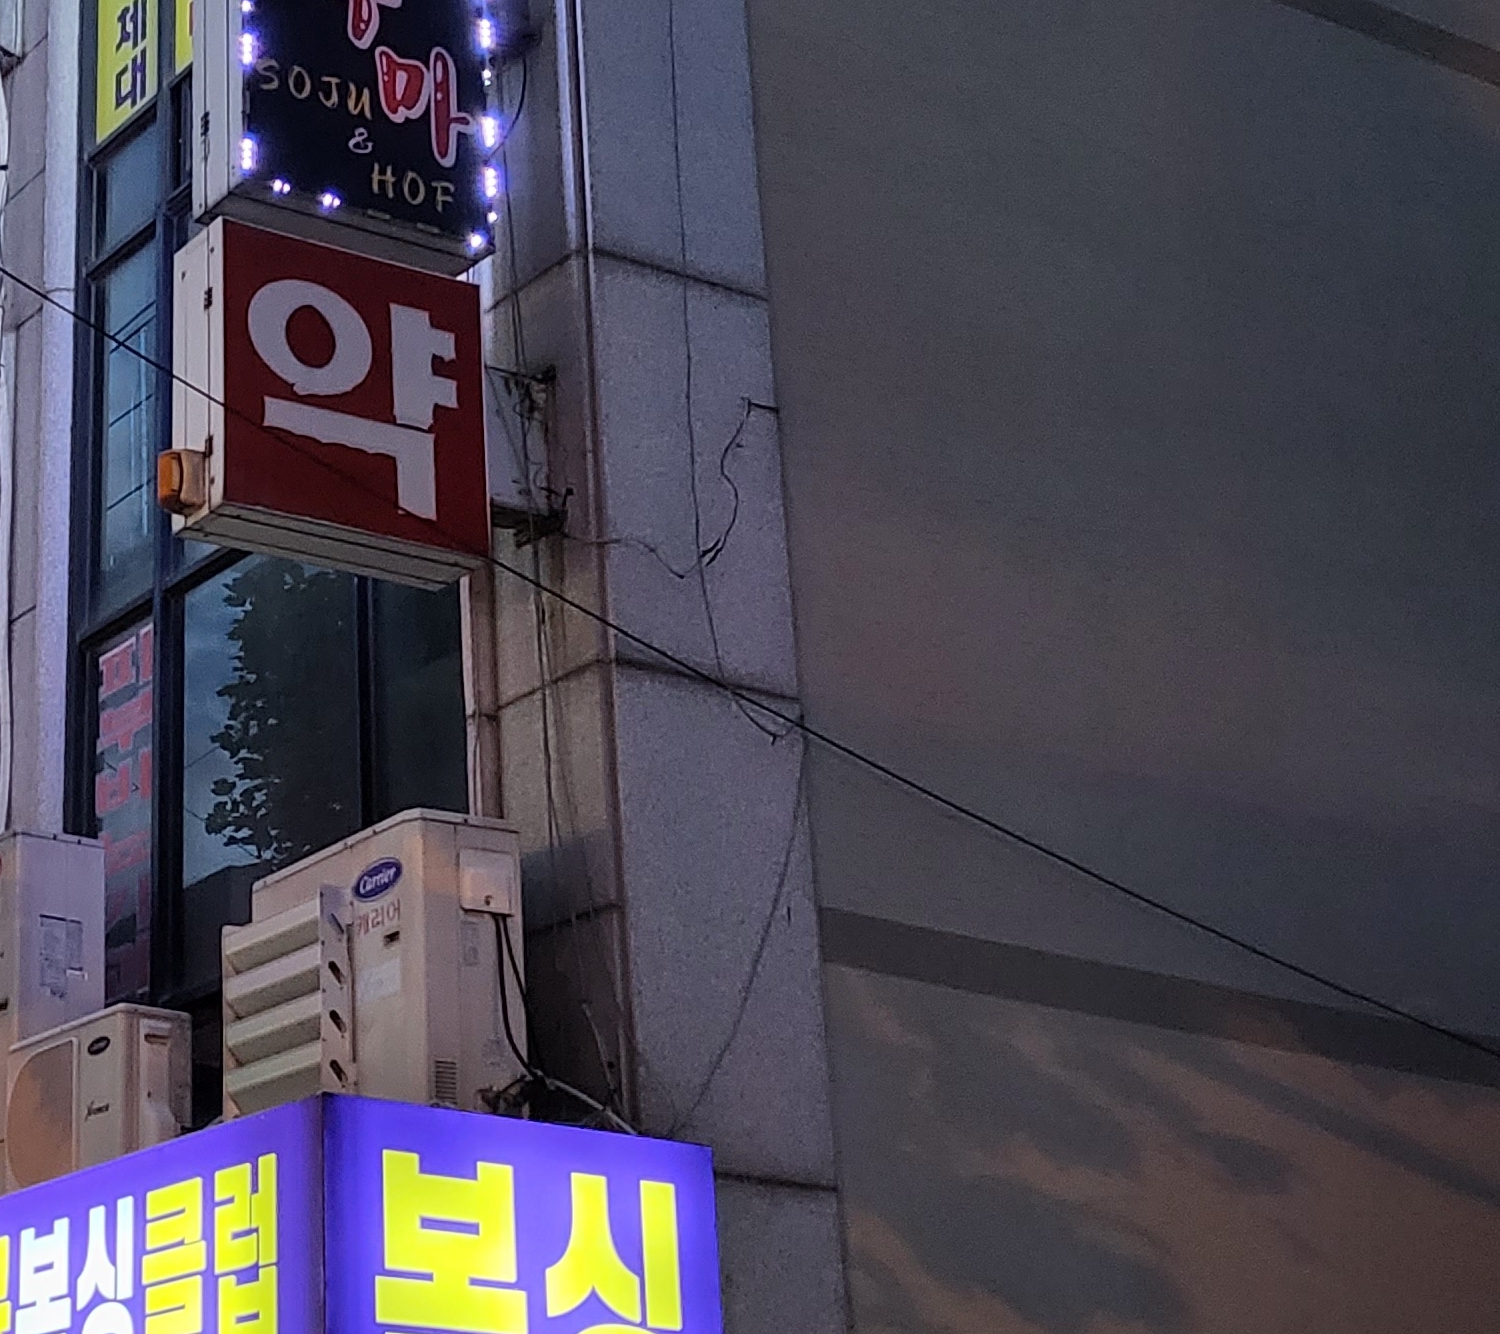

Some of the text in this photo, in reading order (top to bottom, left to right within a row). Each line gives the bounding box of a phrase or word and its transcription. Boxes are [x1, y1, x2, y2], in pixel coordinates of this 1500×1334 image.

[256, 58, 371, 121] SOJU
[370, 162, 456, 215] HOF
[247, 278, 459, 522] 약
